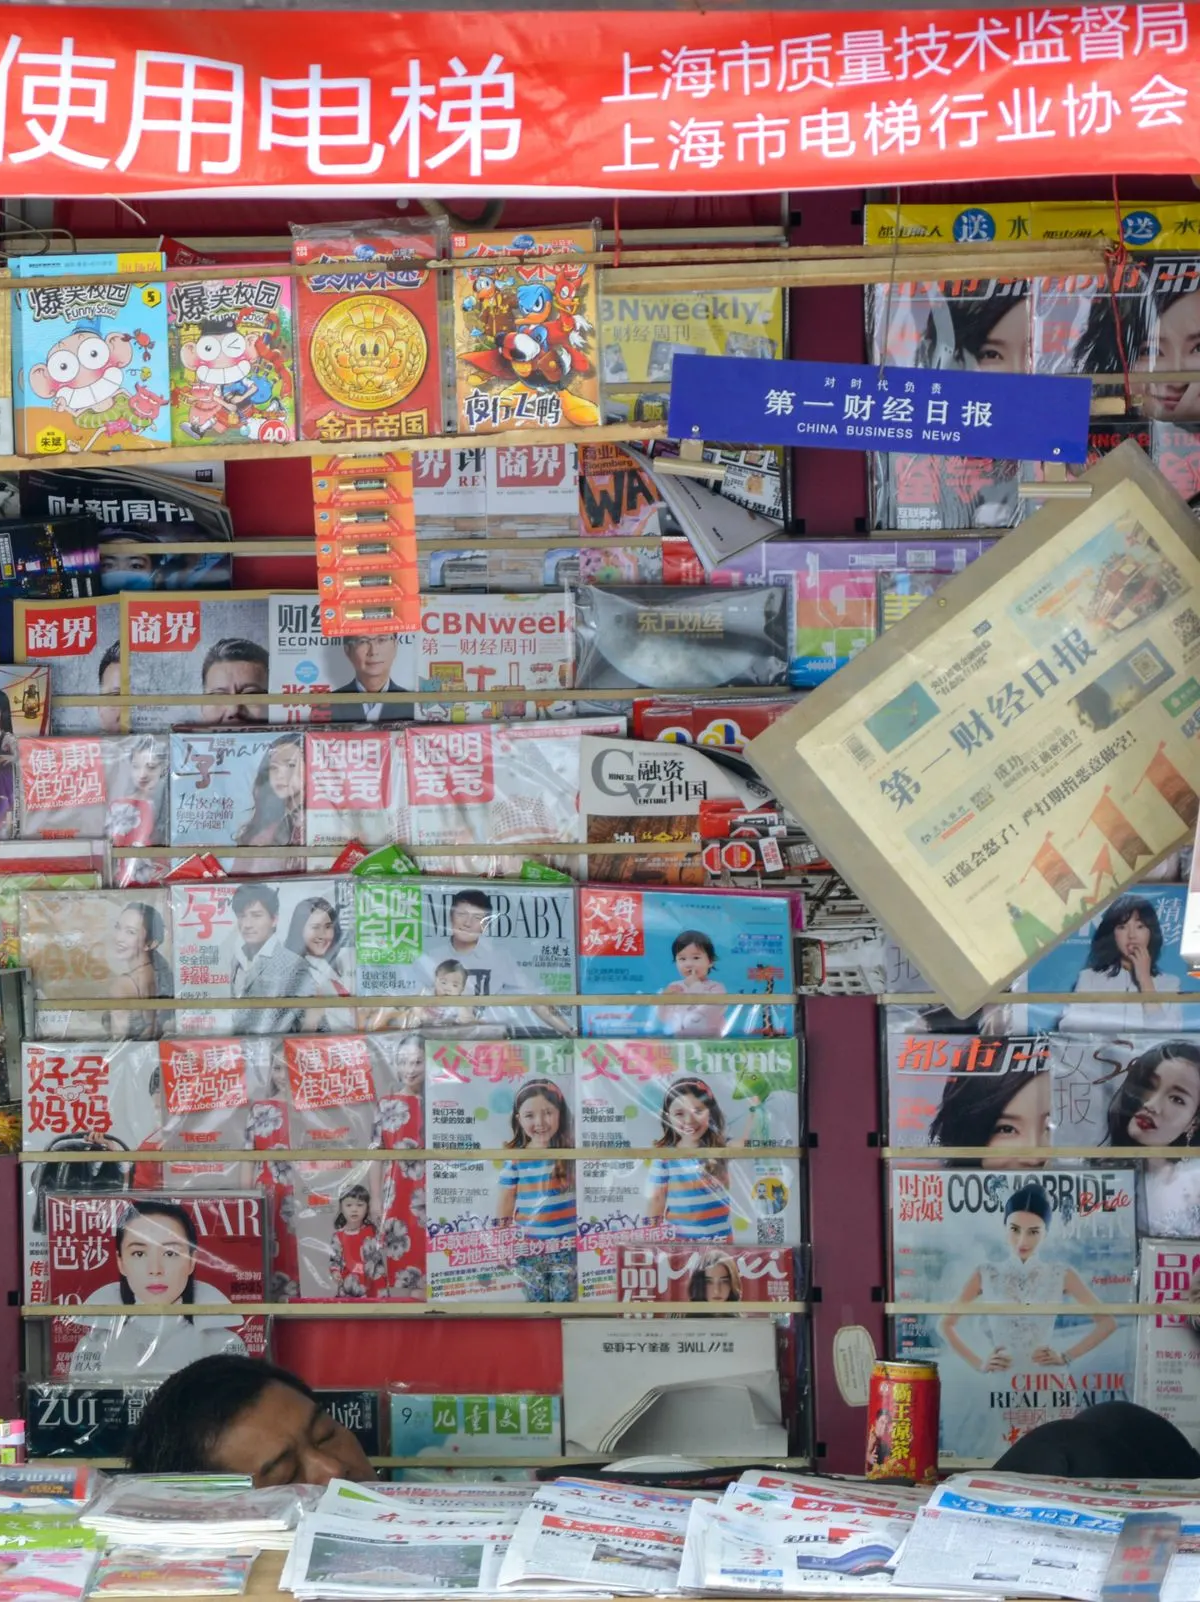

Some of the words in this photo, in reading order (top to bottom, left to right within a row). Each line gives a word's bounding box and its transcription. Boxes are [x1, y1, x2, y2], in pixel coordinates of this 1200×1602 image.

[601, 2, 1189, 105] 上海市质量技术监督局
[601, 73, 1189, 174] 上海市电梯行业协会
[958, 214, 989, 242] 送
[1124, 215, 1156, 239] 送
[64, 305, 96, 321] Funny
[171, 278, 282, 323] 爆笑校园
[823, 376, 943, 396] 对时代负责
[464, 388, 562, 425] 夜行飞鸭
[763, 388, 994, 429] 第一财经日报
[262, 426, 288, 443] 40
[316, 412, 430, 439] 金币帝国
[796, 422, 839, 436] CHINA
[845, 425, 914, 440] BUSINESS
[921, 429, 962, 442] NEWS
[496, 447, 562, 479] 商界
[47, 495, 196, 523] 财新周刊
[27, 614, 94, 650] 商界
[129, 610, 196, 646] 商界
[637, 611, 725, 633] 东方财经
[422, 637, 538, 656] 第一财经周刊
[880, 626, 1100, 814] 第一财经日报
[311, 737, 381, 770] 聪明
[412, 731, 484, 767] 聪明
[312, 768, 381, 803] 宝宝
[413, 763, 486, 799] 宝宝
[637, 759, 686, 782] 融资
[30, 772, 103, 805] 准妈妈
[661, 779, 709, 802] 中国
[178, 886, 234, 940] 孕
[356, 885, 420, 914] 妈咪
[585, 895, 638, 924] 父母
[357, 917, 419, 950] 宝贝
[582, 926, 638, 954] 必读
[26, 1054, 110, 1095] 好孕
[677, 1043, 794, 1076] Parents
[167, 1072, 244, 1104] 准妈妈
[294, 1069, 370, 1102] 准妈妈
[26, 1094, 113, 1134] 妈妈
[898, 1173, 944, 1200] 时尚
[50, 1199, 101, 1236] 时尚
[898, 1199, 945, 1223] 新娘
[1078, 1188, 1132, 1218] Bride
[52, 1236, 109, 1271] 芭莎
[677, 1341, 705, 1354] TIME
[1010, 1372, 1076, 1393] CHINA
[36, 1398, 101, 1426] ZUI
[401, 1406, 413, 1425] 9
[989, 1391, 1046, 1409] REAL
[433, 1401, 554, 1434] 儿童文学
